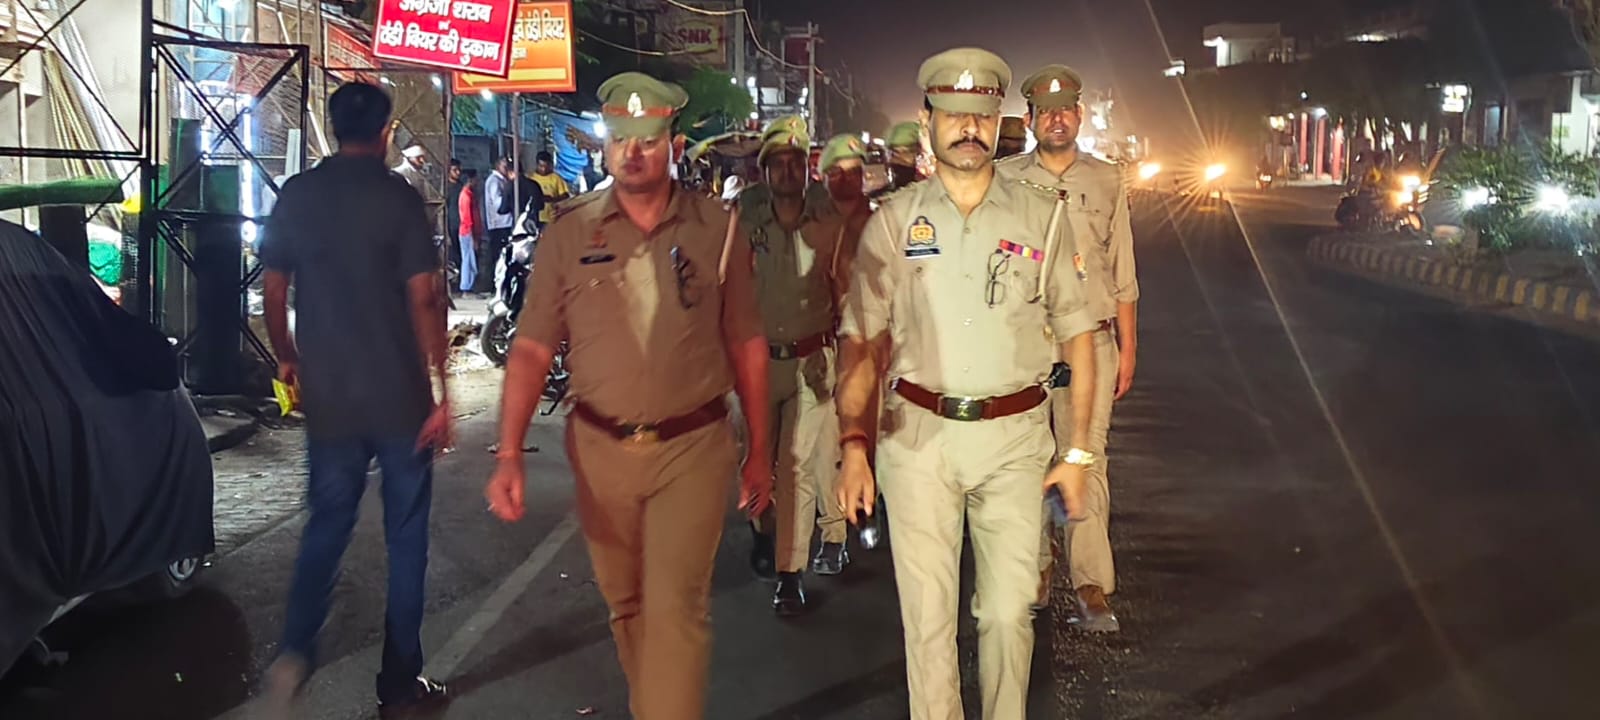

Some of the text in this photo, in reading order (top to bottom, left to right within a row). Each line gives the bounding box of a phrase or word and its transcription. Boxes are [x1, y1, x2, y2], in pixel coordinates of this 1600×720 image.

[379, 19, 501, 66] ठंडी बियर की दुकान
